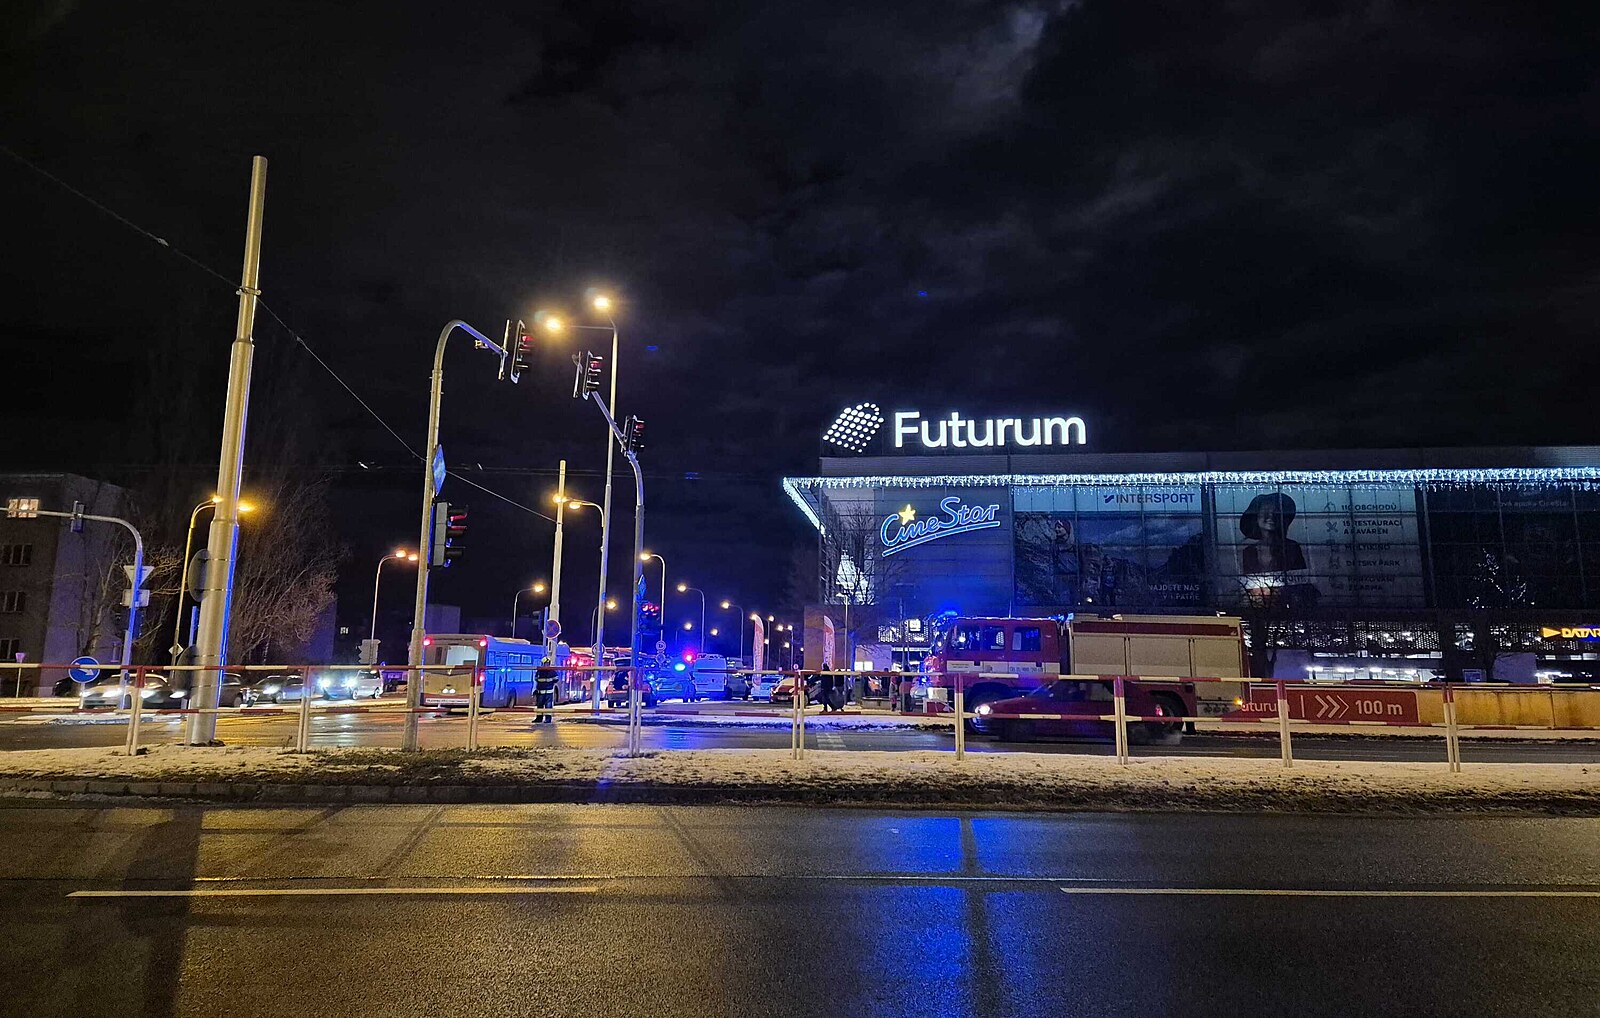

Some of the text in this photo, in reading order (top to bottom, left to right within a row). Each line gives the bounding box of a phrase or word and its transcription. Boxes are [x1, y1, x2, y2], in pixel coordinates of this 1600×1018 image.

[895, 411, 1087, 448] Futurum
[1116, 493, 1195, 504] INTERSPORT
[880, 496, 1000, 547] CineStar
[1355, 700, 1383, 715] 100
[1387, 703, 1403, 715] m
